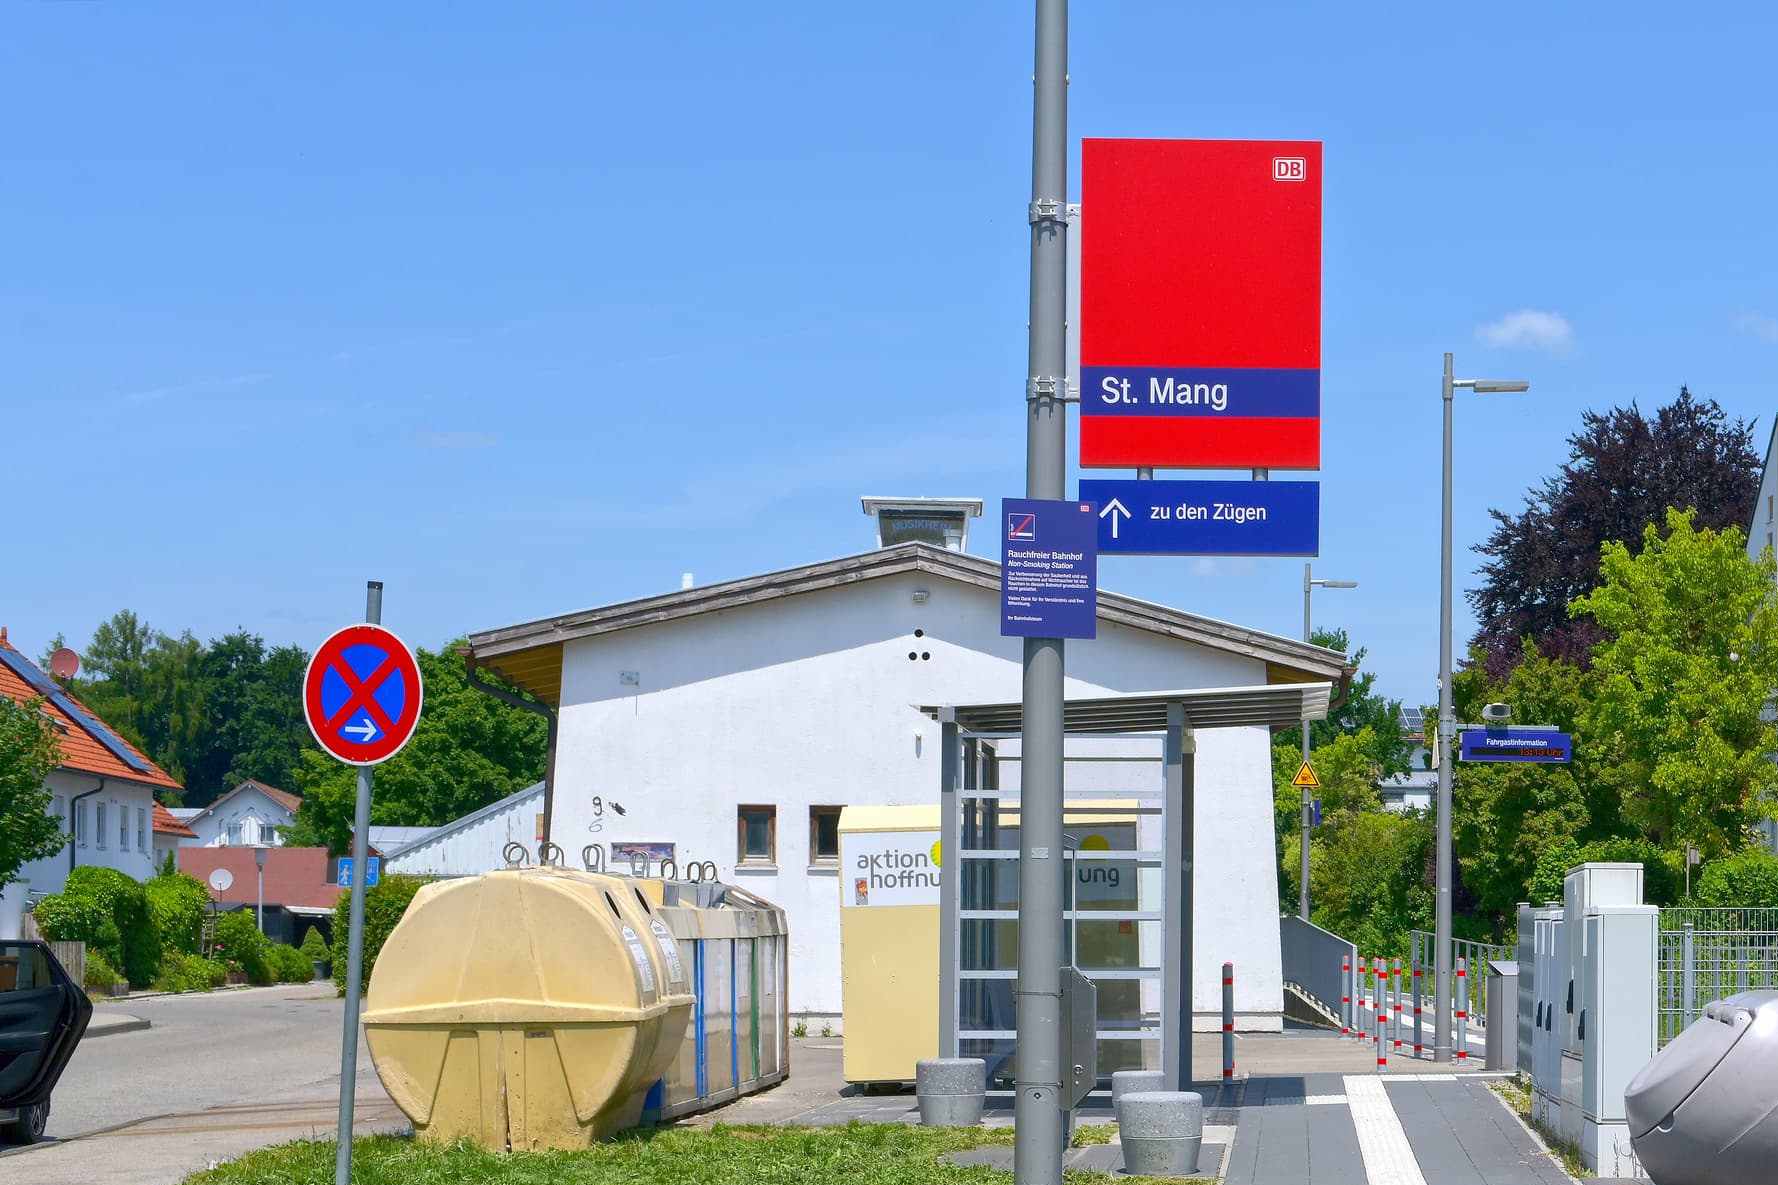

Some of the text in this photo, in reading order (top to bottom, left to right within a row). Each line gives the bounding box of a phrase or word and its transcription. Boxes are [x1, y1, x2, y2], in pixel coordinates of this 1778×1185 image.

[1276, 160, 1303, 178] DB
[1101, 376, 1228, 411] St. Mang
[1150, 503, 1267, 524] zu den Zügen
[1008, 550, 1083, 560] Rauchfreier Bahnhof
[1008, 560, 1050, 569] Non-Smoking
[1486, 738, 1548, 747] Fahrgastinformation
[857, 849, 928, 869] aktion
